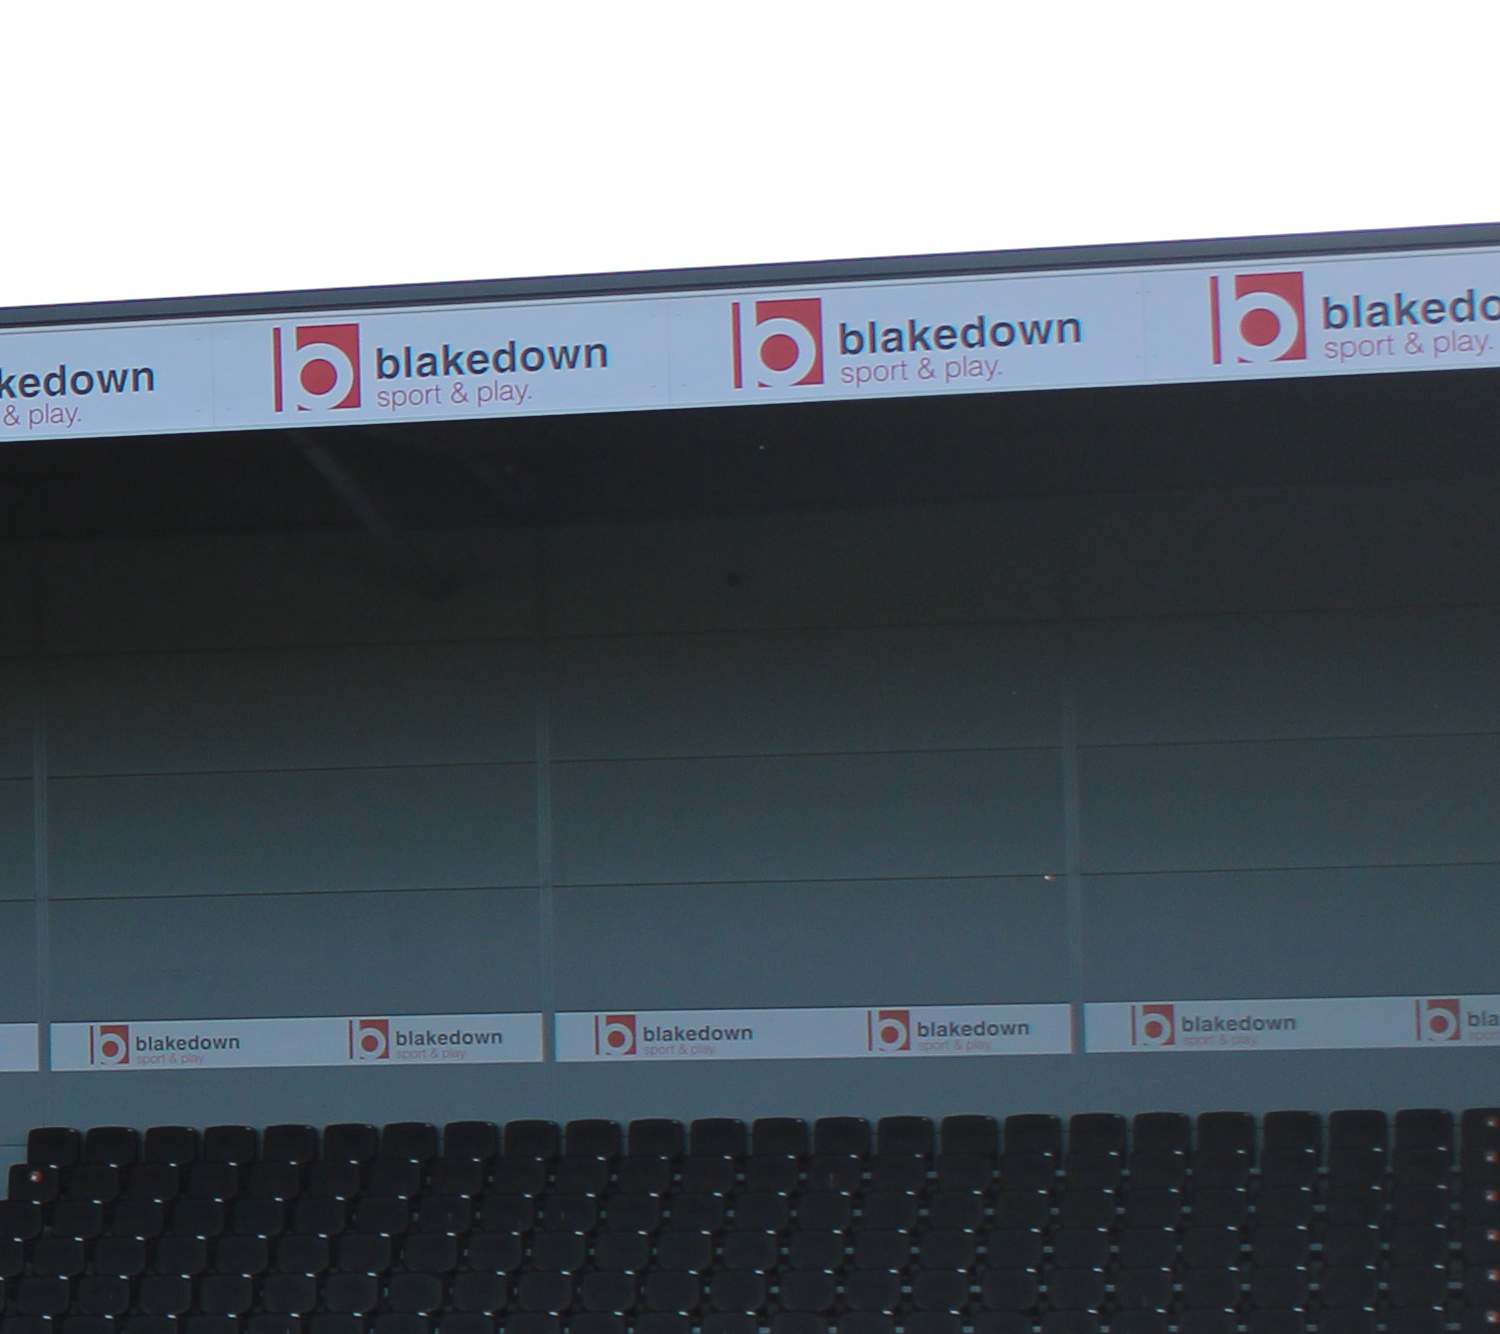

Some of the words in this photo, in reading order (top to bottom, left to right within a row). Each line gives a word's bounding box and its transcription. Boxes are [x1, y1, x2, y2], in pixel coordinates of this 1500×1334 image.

[839, 314, 1081, 356] blakedown
[1325, 335, 1394, 364] sport
[1405, 331, 1424, 355] &
[1434, 330, 1485, 359] play.
[376, 340, 608, 380] blakedown
[841, 360, 908, 388] sport
[918, 357, 936, 380] &
[946, 355, 998, 384] play.
[377, 385, 441, 412] sport
[451, 381, 468, 404] &
[478, 379, 530, 407] play.
[3, 404, 20, 427] &
[29, 403, 81, 430] play.
[643, 1025, 752, 1042] blakedown
[917, 1020, 1029, 1037] blakedown
[1182, 1015, 1296, 1032] blakedown
[136, 1034, 239, 1051] blakedown
[396, 1029, 502, 1046] blakedown
